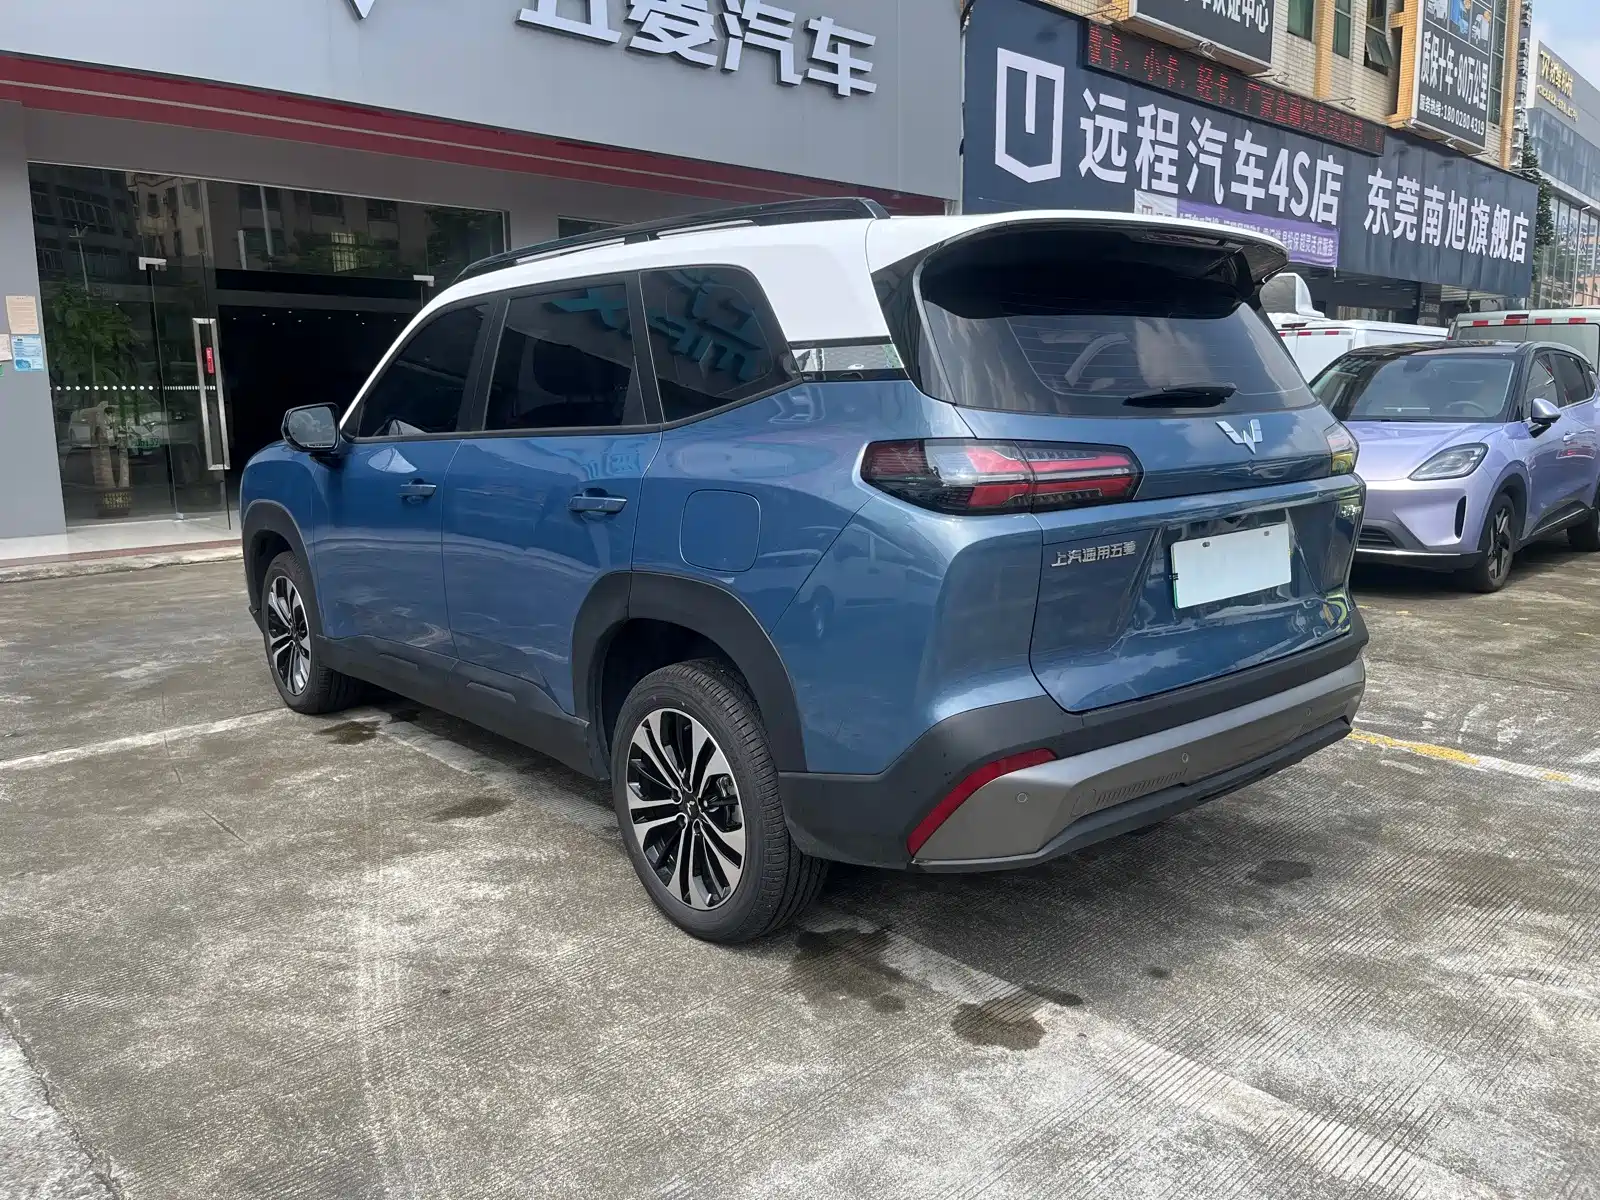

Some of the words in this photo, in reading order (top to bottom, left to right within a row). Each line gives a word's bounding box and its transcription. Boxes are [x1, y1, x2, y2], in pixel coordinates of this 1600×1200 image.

[1079, 88, 1343, 225] 远程汽车4S店
[1364, 168, 1529, 263] 东莞南旭旗舰店
[1051, 541, 1136, 567] 上汽通用五菱
